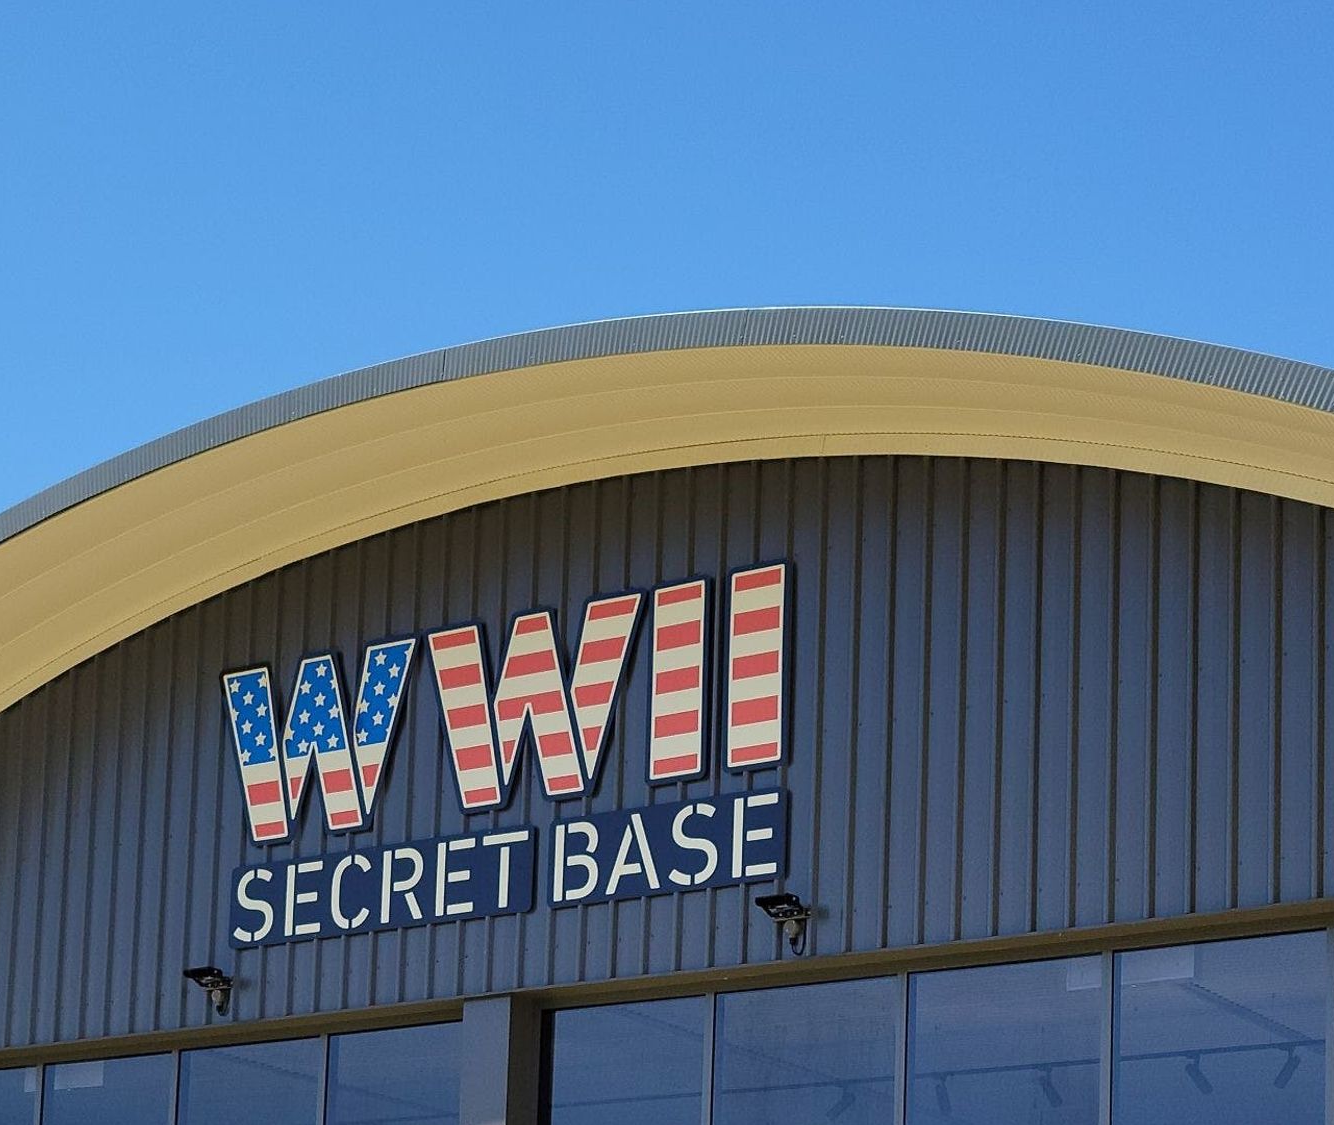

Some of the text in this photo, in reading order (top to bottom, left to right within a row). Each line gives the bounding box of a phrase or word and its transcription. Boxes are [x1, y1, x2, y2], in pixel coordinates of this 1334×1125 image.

[223, 563, 786, 842] WWII
[233, 792, 780, 943] SECRET BASE
